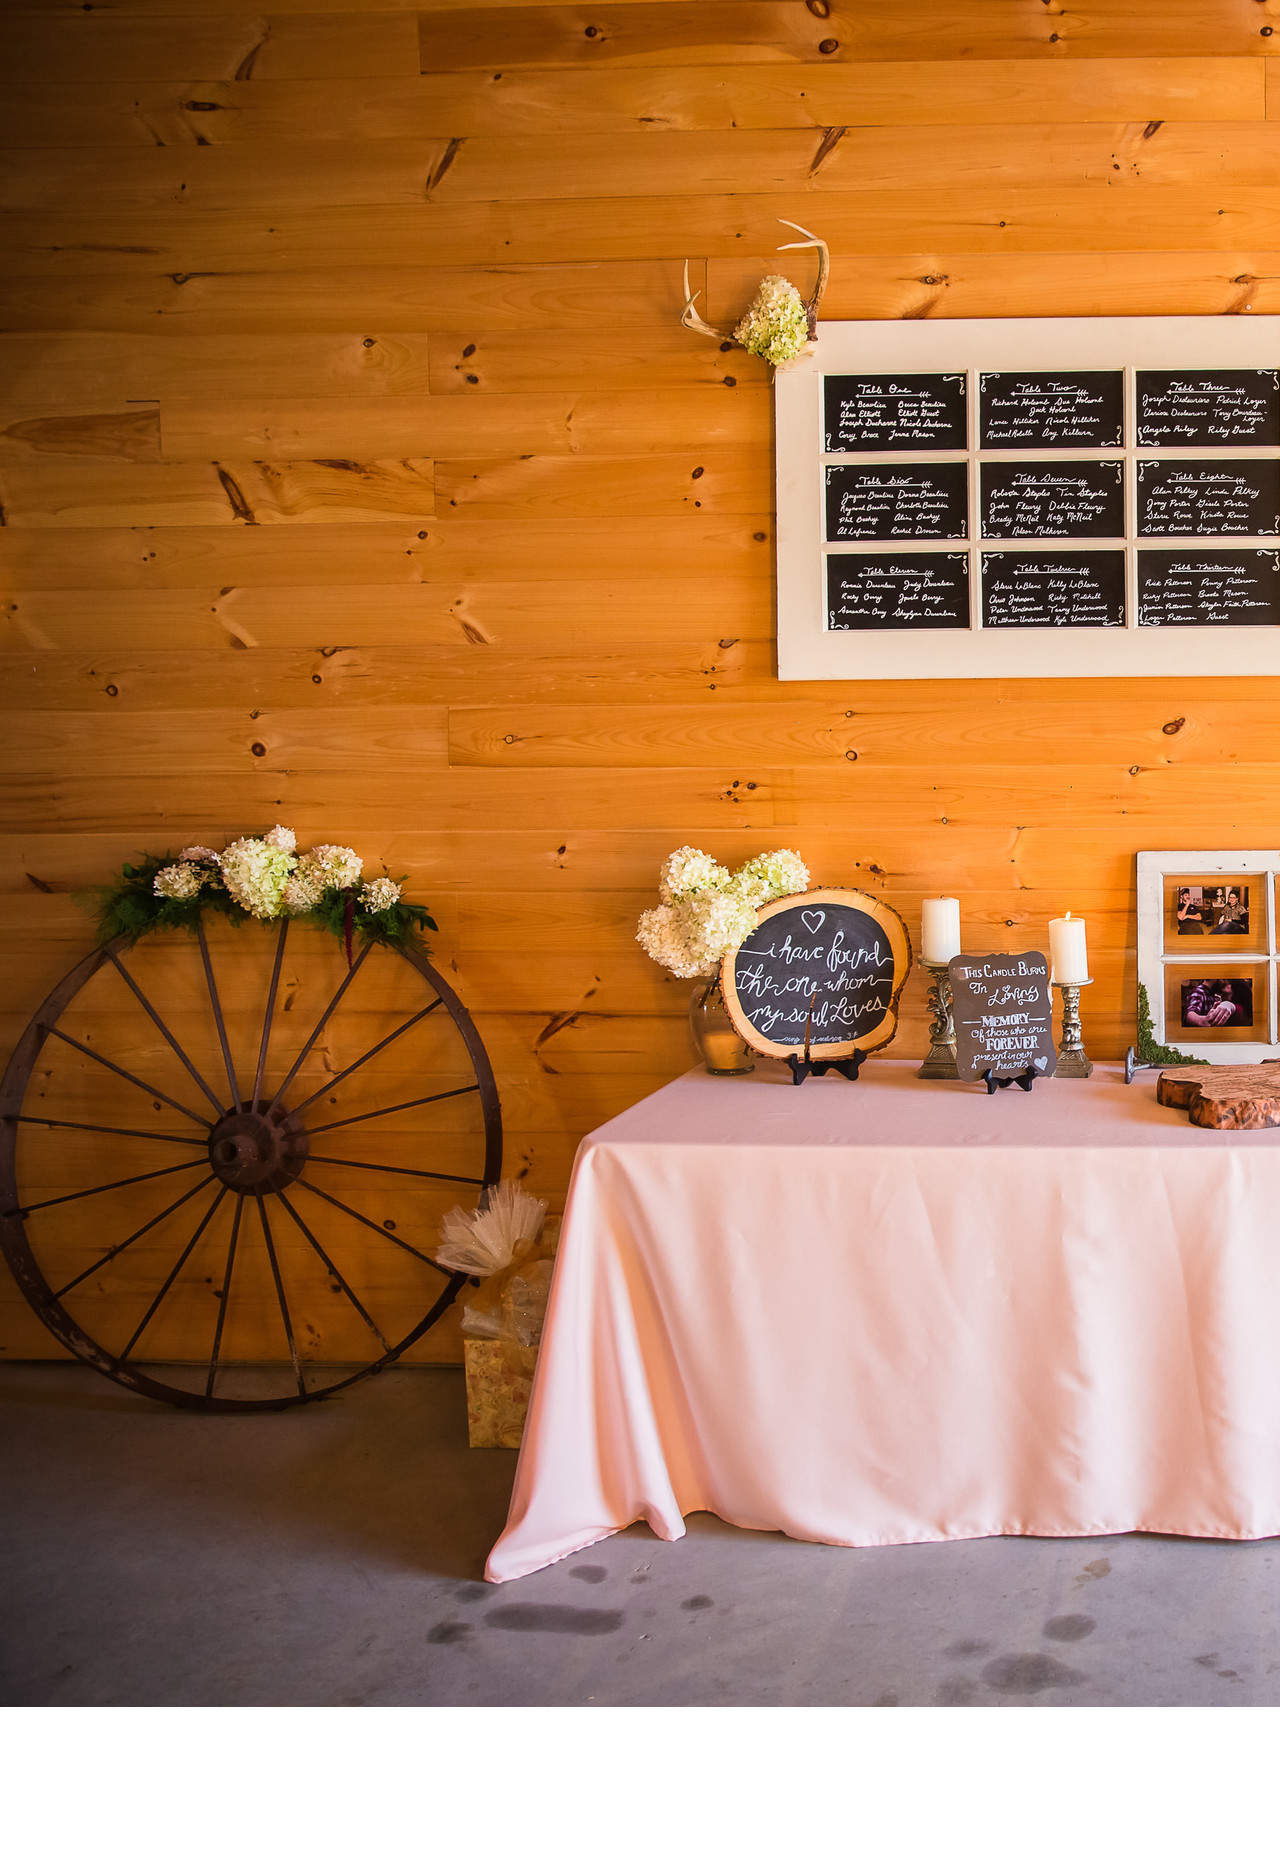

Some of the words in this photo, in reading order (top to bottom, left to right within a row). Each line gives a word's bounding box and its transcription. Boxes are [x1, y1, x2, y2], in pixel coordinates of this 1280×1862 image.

[858, 384, 882, 394] Table
[889, 384, 912, 393] One
[1017, 383, 1040, 393] Table
[1048, 383, 1077, 391] Two
[1170, 382, 1194, 391] Table
[1199, 382, 1230, 390] Three
[992, 398, 1018, 406] Richard
[1055, 398, 1070, 406] Sue
[1143, 394, 1170, 406] Joseph
[1216, 395, 1241, 404] Patrick
[840, 401, 855, 410] Kyle
[1029, 407, 1046, 416] Jack
[1049, 406, 1076, 414] Holcomb
[839, 419, 863, 427] Joseph
[986, 430, 1011, 439] Michael
[1142, 425, 1171, 436] Angela
[1173, 426, 1198, 436] Riley
[1208, 426, 1230, 438] Riley
[859, 477, 881, 485] Table
[887, 476, 913, 484] Six
[1015, 473, 1036, 483] Table
[1041, 474, 1076, 482] Seven
[1171, 472, 1193, 480] Table
[1200, 472, 1234, 481] Eight
[991, 488, 1019, 498] Roberta
[1022, 488, 1050, 500] Staples
[1077, 487, 1107, 499] Staples
[1152, 486, 1171, 494] Alan
[989, 502, 1009, 514] John
[1016, 502, 1041, 514] Fleury
[1049, 501, 1076, 510] Debbie
[1078, 502, 1106, 514] Fleury
[1016, 514, 1039, 524] McNeil
[1067, 512, 1092, 522] McNeil
[1144, 511, 1169, 519] Steve
[1200, 511, 1224, 519] Krista
[1142, 524, 1165, 532] Scott
[1168, 524, 1192, 532] Boucher
[1221, 523, 1248, 532] Boucher
[1043, 564, 1076, 572] Twelve
[991, 581, 1012, 591] Steve
[1015, 582, 1041, 590] LeBlanc
[1047, 580, 1067, 591] Kelly
[1164, 578, 1192, 586] Patterson
[989, 594, 1005, 604] Chris
[1008, 594, 1035, 605] Johnson
[838, 606, 870, 614] Samantha
[990, 606, 1008, 614] Peter
[1072, 604, 1107, 612] Underwood
[1054, 615, 1067, 625] Kyle
[1167, 613, 1197, 621] Patterson
[779, 935, 824, 964] have
[827, 931, 885, 972] found
[960, 967, 982, 979] THIS
[983, 964, 1016, 978] CANDLE
[1018, 961, 1045, 976] BURNS
[736, 964, 777, 997] the
[785, 976, 822, 997] one
[824, 971, 879, 992] whom
[969, 982, 987, 994] In
[988, 985, 1039, 1006] Loving
[750, 1005, 783, 1032] my
[830, 997, 883, 1024] Loves
[981, 1012, 1030, 1027] MEMORY
[986, 1027, 1009, 1036] those
[1010, 1026, 1026, 1035] who
[986, 1036, 1039, 1051] FOREVER
[971, 1051, 1007, 1069] present
[1017, 1051, 1032, 1059] our
[995, 1060, 1029, 1070] hearts
